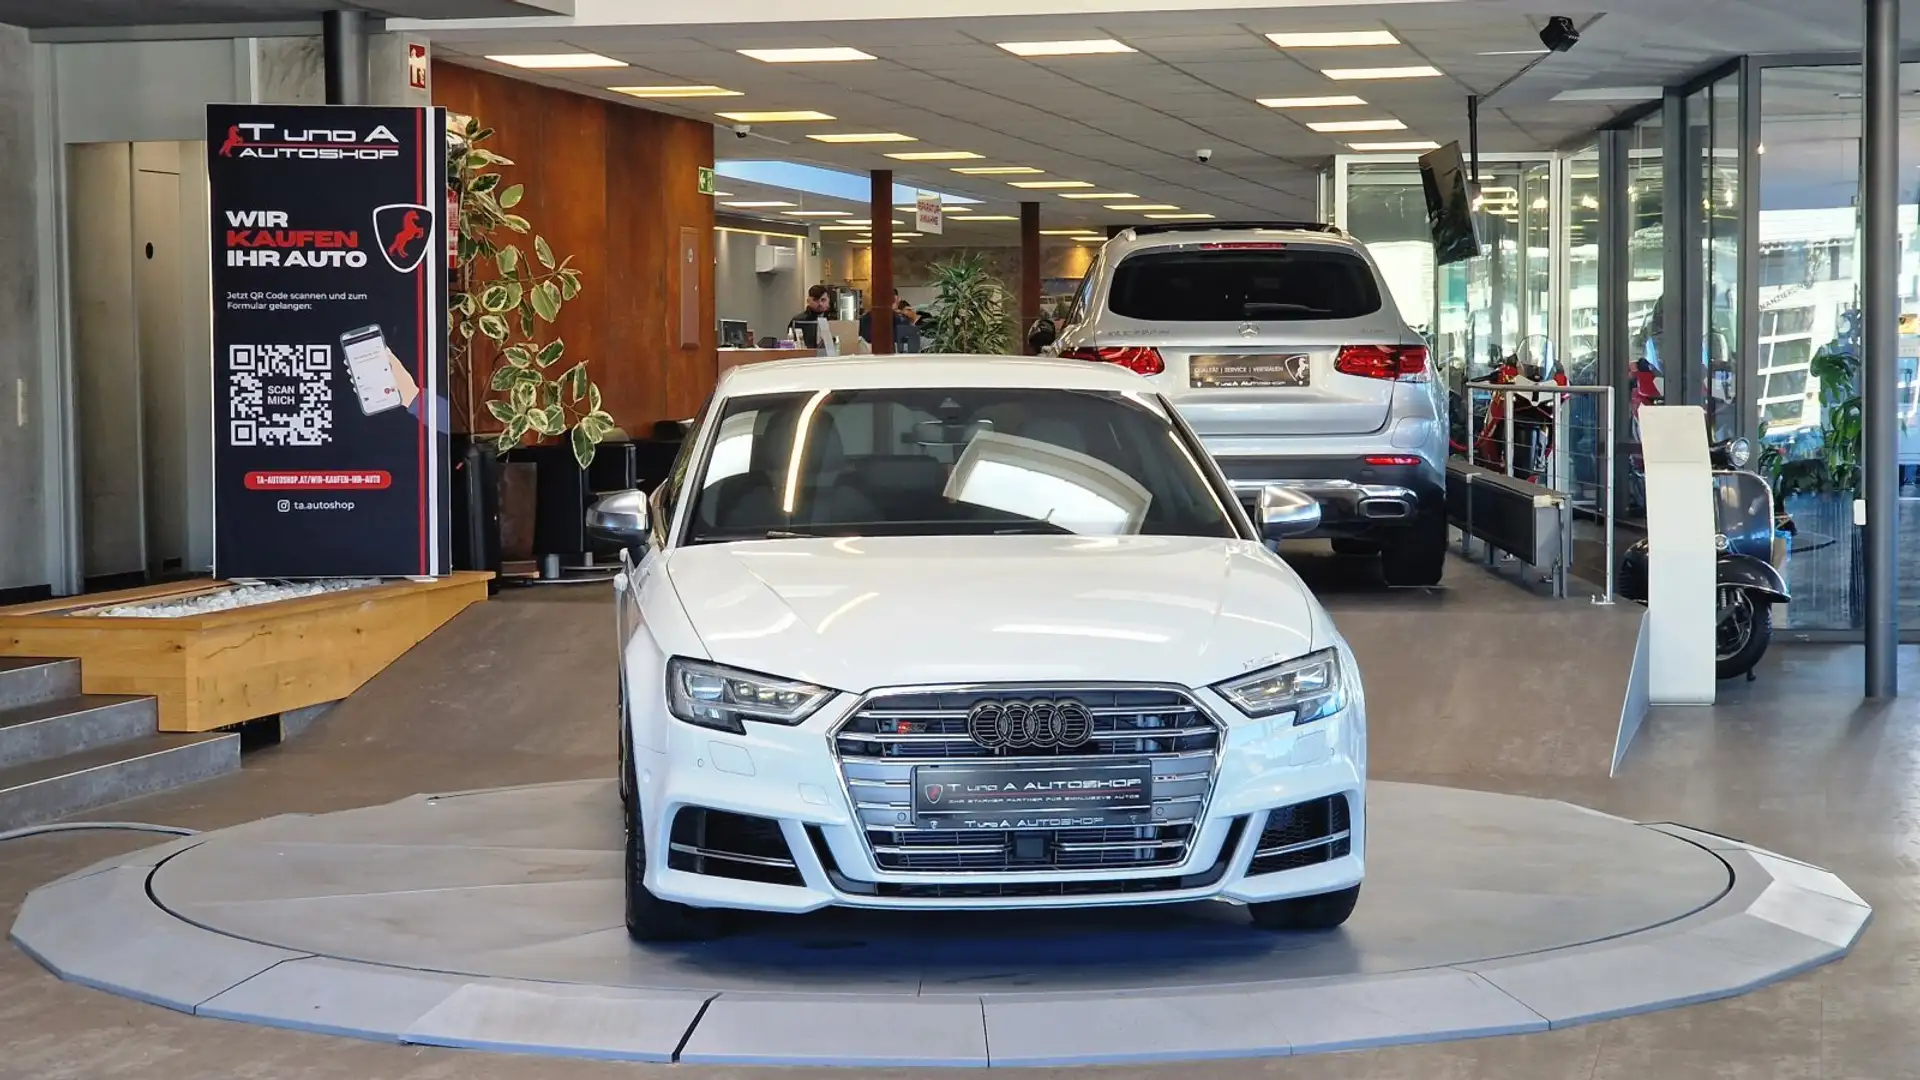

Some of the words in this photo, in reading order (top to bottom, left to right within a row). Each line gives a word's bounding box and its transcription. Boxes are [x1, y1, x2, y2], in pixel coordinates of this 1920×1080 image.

[238, 123, 275, 141] T
[364, 125, 399, 143] A
[239, 148, 399, 159] AUTOSHOP
[226, 211, 288, 228] WIR
[226, 231, 358, 248] KAUFEN
[227, 250, 280, 267] IHR
[283, 250, 368, 268] AUTO
[227, 292, 248, 300] Jetzt
[250, 292, 264, 301] QR
[266, 292, 288, 300] Code
[329, 292, 346, 300] und
[227, 302, 266, 310] Formular
[269, 302, 312, 312] gelangen:
[267, 385, 295, 395] SCAN
[267, 396, 295, 405] MICH
[256, 475, 381, 484] TA-AUTOSHOP.AT/WIR-KAUFEN-IHR-AUTO
[293, 501, 355, 511] ta.autoshop
[1003, 782, 1018, 791] A
[1023, 779, 1142, 790] AUTOSHOP
[1017, 817, 1105, 827] AUTOSHOP
